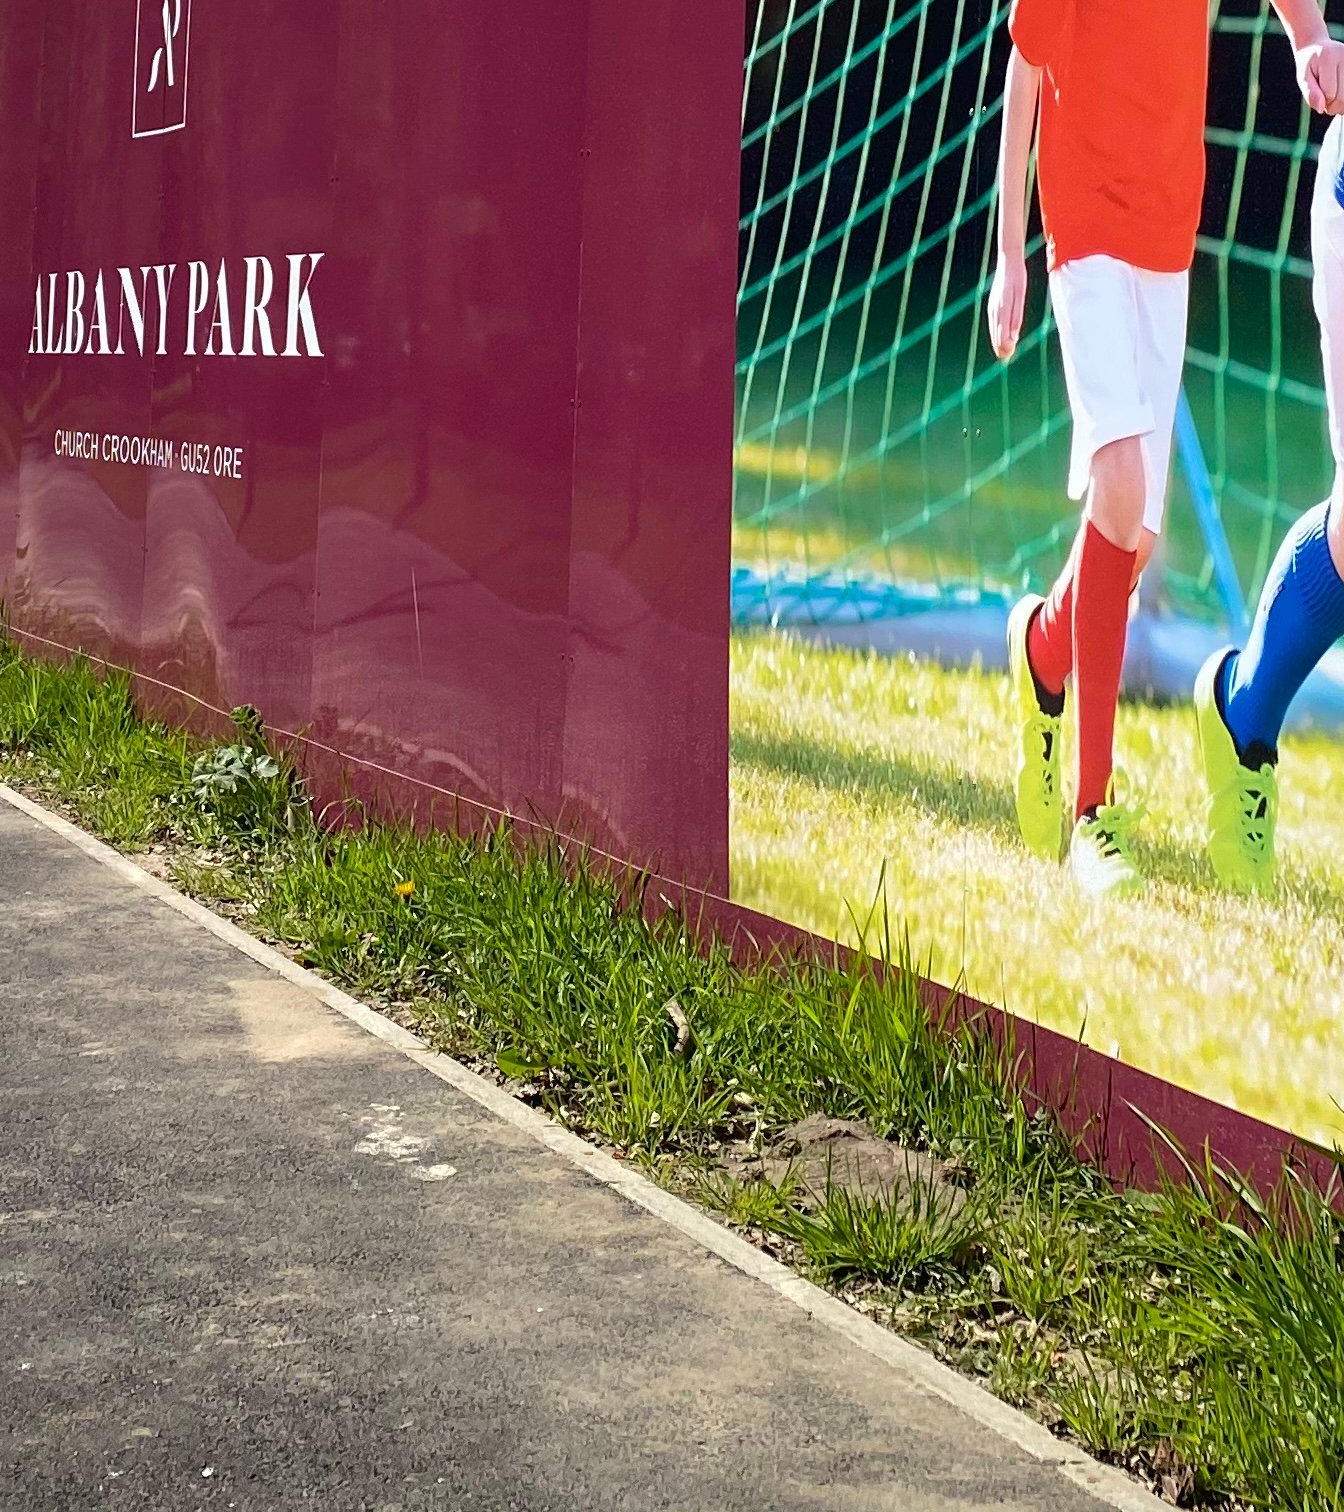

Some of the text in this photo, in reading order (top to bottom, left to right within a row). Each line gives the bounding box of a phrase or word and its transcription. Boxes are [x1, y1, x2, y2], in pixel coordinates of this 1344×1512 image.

[28, 253, 325, 358] ALBANY PARK
[55, 429, 99, 460] CHURCH
[102, 433, 173, 469] CROOKHAM
[180, 441, 210, 475] GU52
